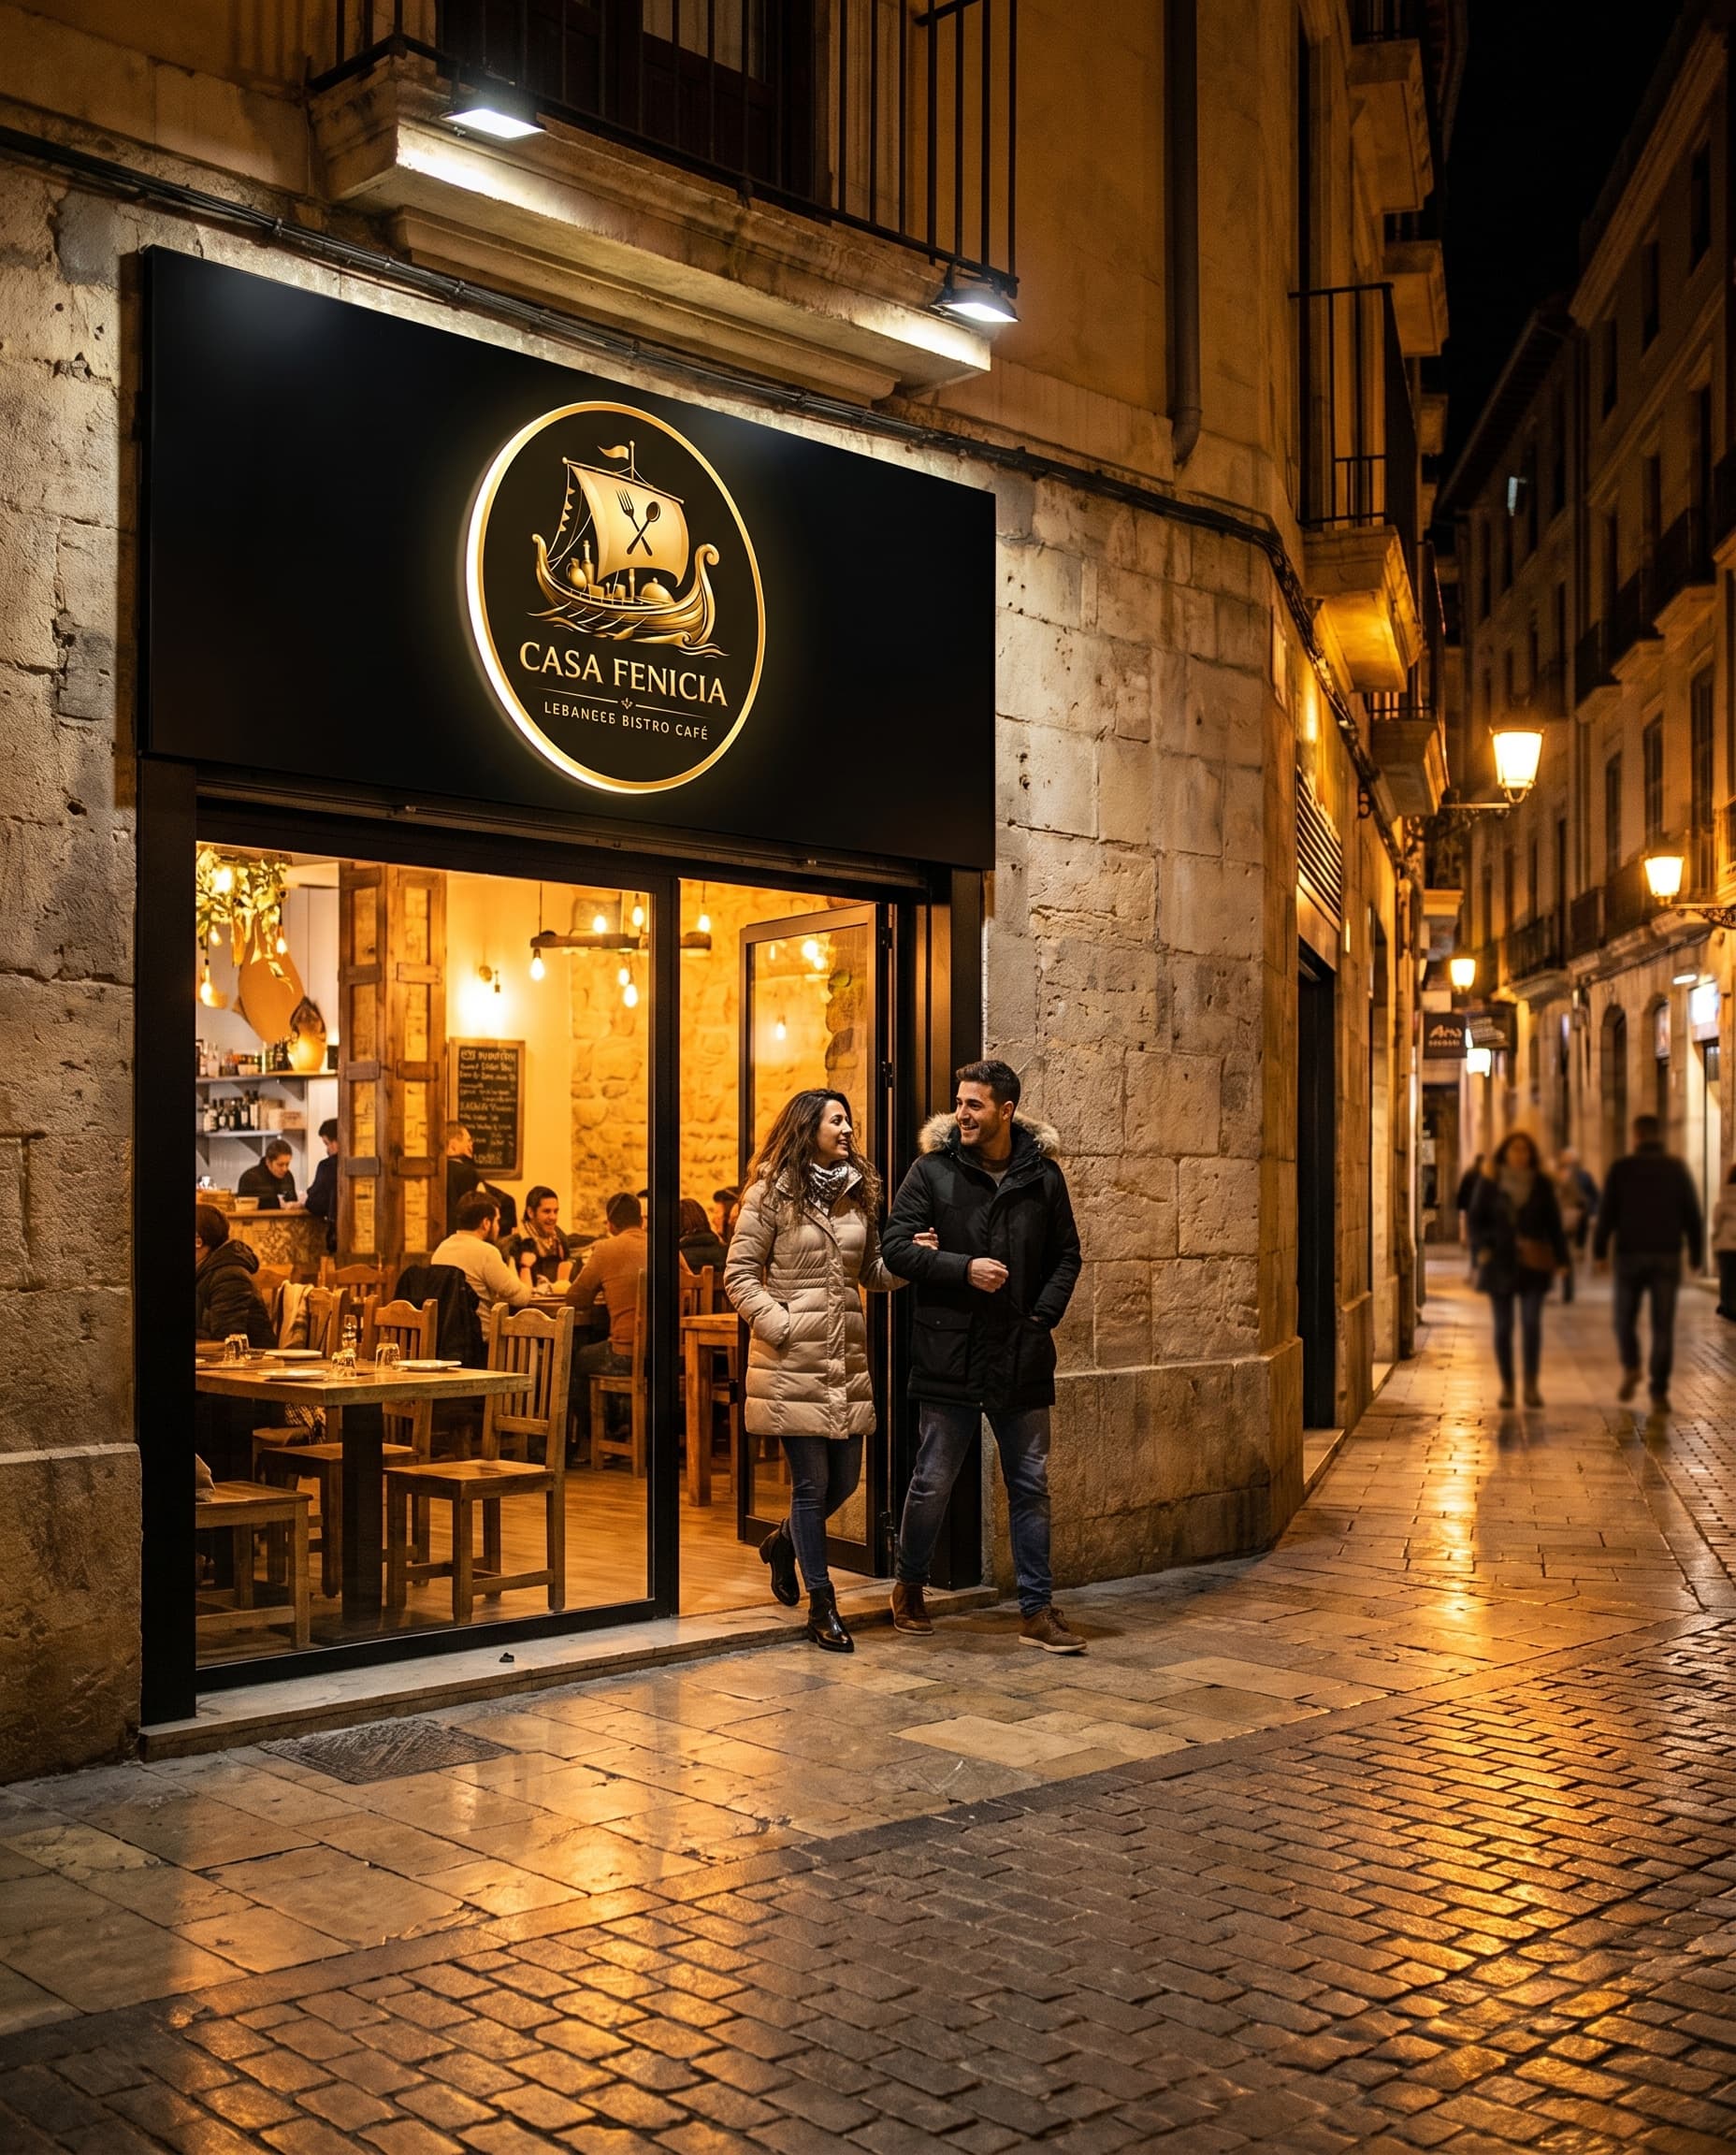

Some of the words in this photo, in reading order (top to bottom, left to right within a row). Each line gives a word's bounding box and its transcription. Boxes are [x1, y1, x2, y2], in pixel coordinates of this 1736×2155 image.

[519, 642, 604, 684] CASA
[613, 658, 728, 707] FENICIA
[622, 715, 670, 733] BISTRO
[675, 724, 708, 740] CAFÉ
